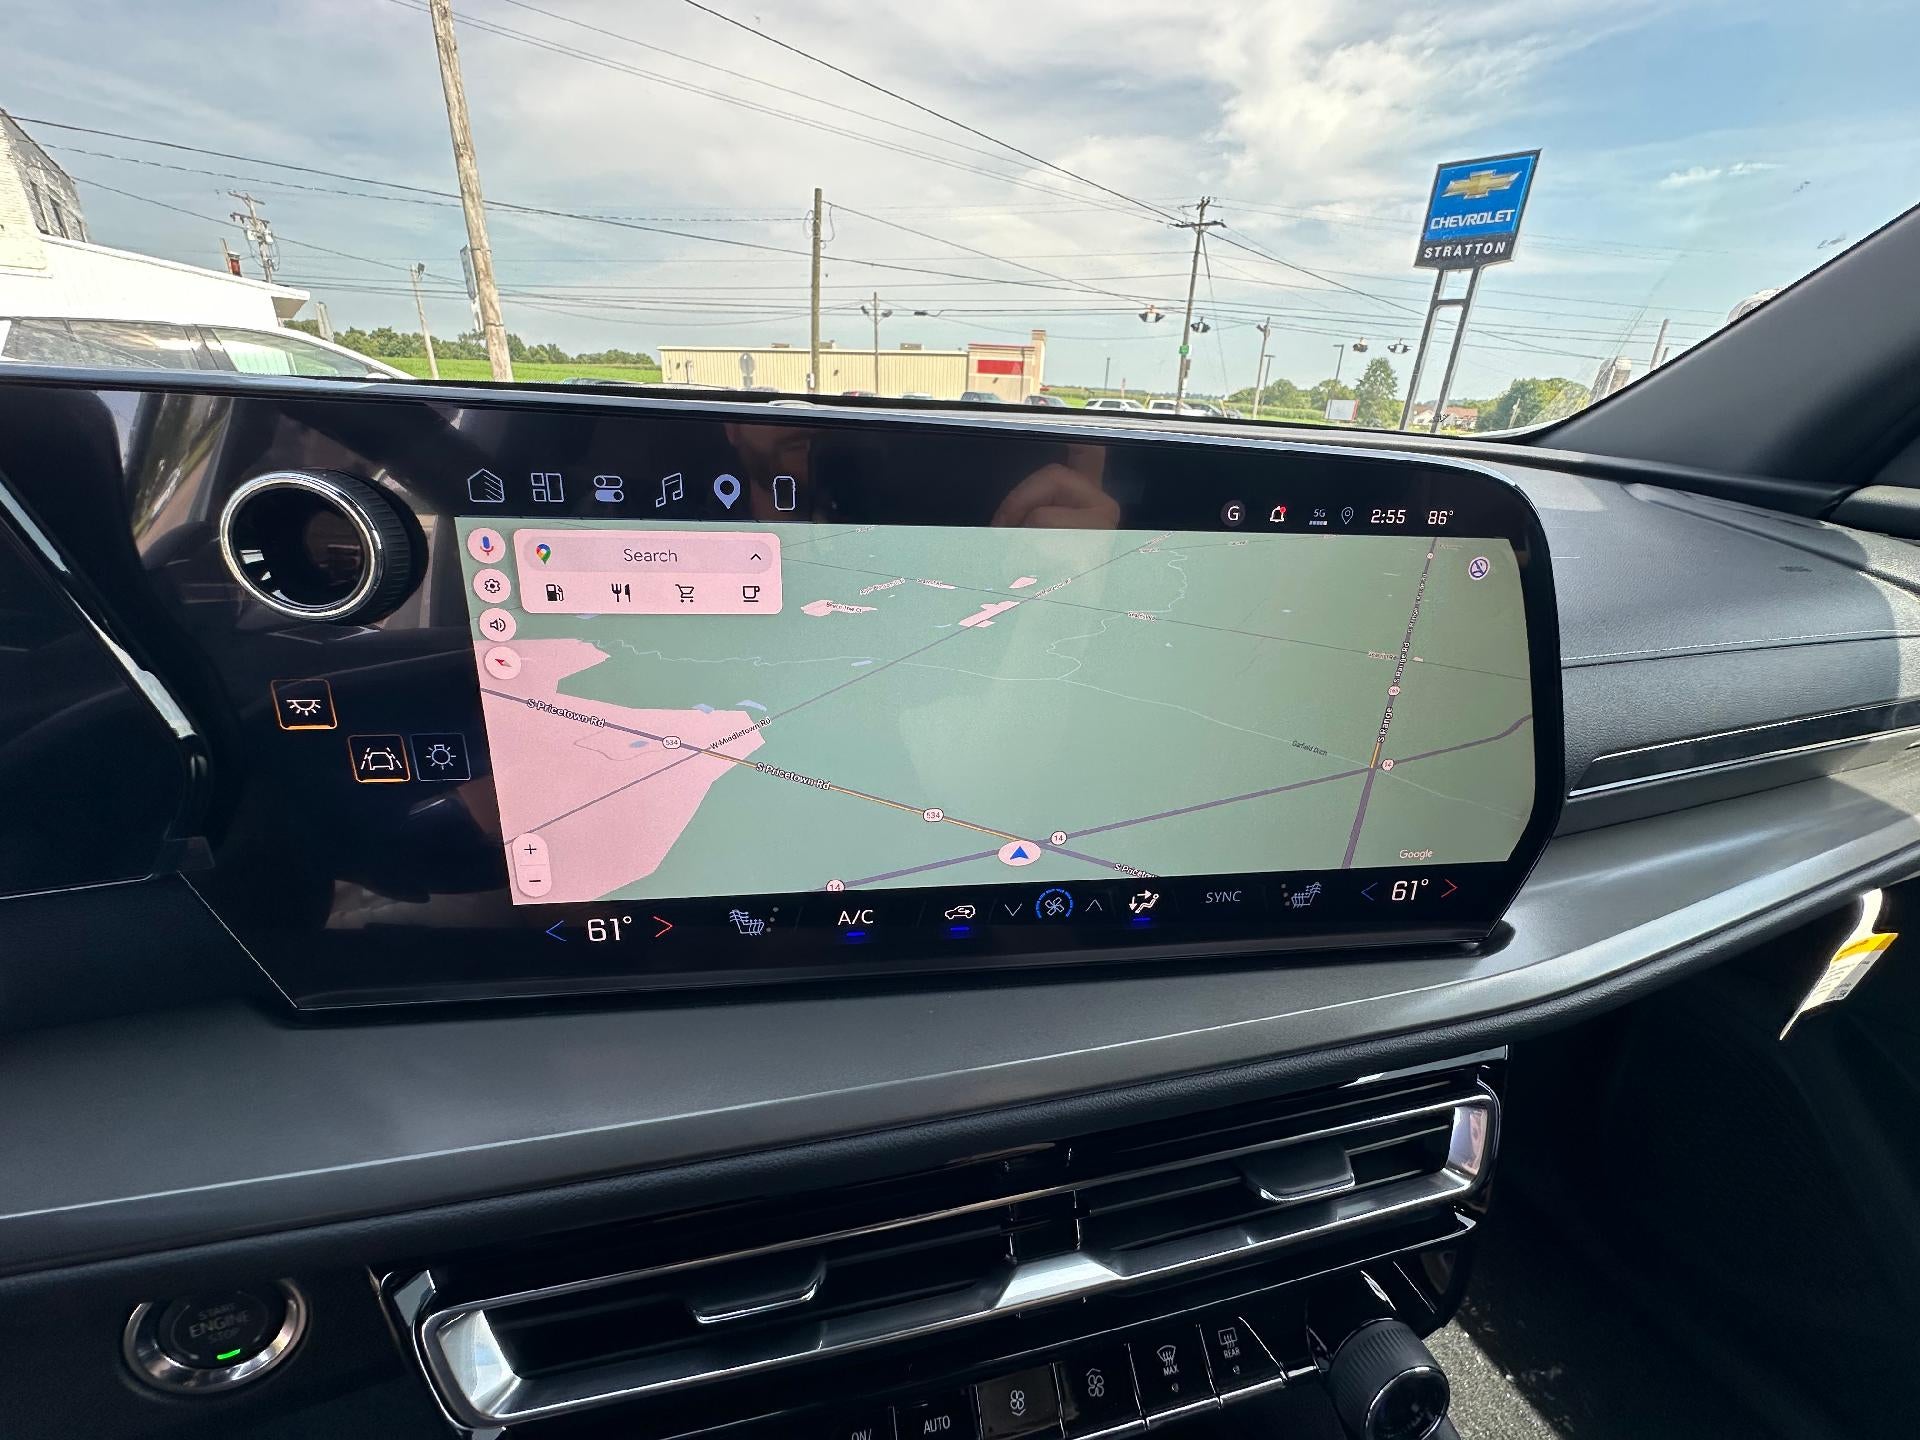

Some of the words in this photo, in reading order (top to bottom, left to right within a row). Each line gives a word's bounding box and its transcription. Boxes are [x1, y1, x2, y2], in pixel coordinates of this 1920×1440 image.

[1430, 209, 1515, 230] CHEVROLET
[1424, 241, 1506, 259] STRATTON
[1227, 504, 1240, 521] G
[1313, 508, 1326, 518] 5G
[1370, 509, 1406, 524] 2:55
[623, 548, 678, 563] Search
[527, 698, 535, 708] S
[536, 700, 589, 723] Pricetown
[589, 716, 606, 728] Rd
[1379, 706, 1393, 737] Range
[665, 738, 679, 747] 534
[719, 723, 760, 746] Middletown
[756, 762, 765, 772] S
[765, 765, 814, 786] Pricetown
[816, 778, 832, 791] Rd
[926, 811, 940, 819] 534
[1054, 833, 1064, 842] 14
[1399, 848, 1433, 861] Google
[1205, 890, 1243, 904] SYNC
[1391, 878, 1429, 901] 61°
[837, 909, 875, 926] A/C
[587, 915, 632, 942] 61°
[1223, 1347, 1240, 1359] REAR
[1163, 1365, 1179, 1376] MAX
[923, 1415, 950, 1434] AUTO
